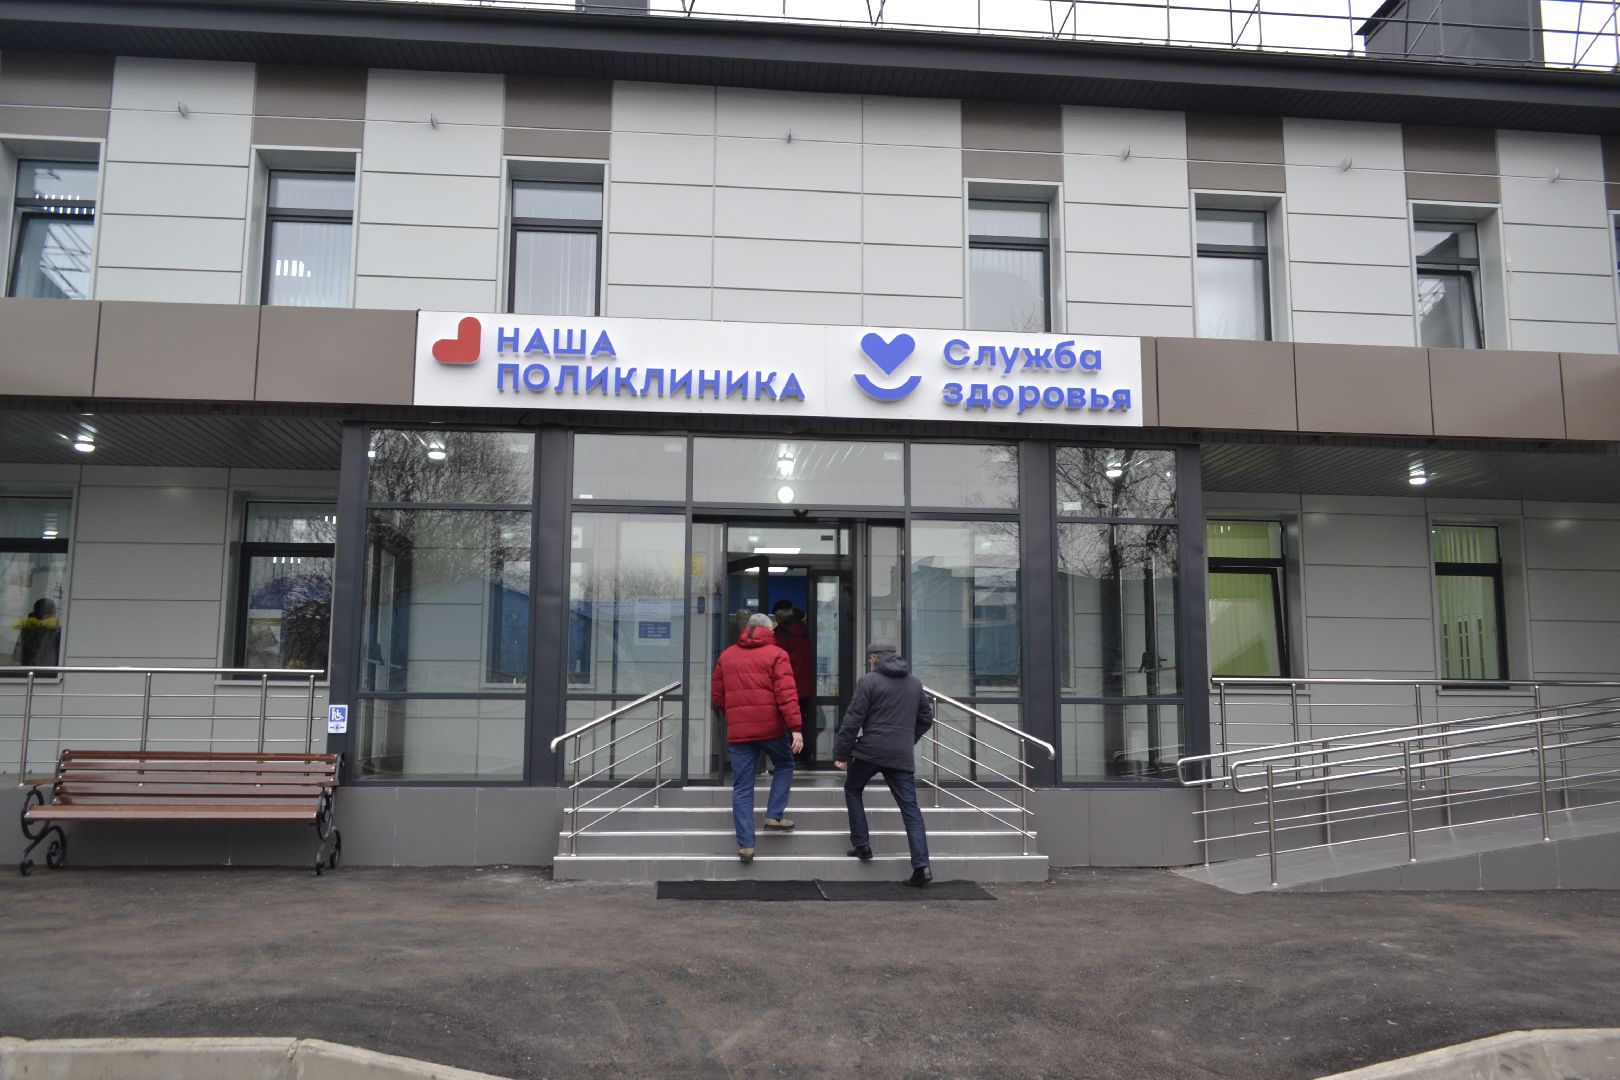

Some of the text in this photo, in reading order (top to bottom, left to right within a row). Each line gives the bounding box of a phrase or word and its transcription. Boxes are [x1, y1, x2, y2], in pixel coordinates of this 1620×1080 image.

[497, 327, 617, 357] НАША
[943, 339, 1102, 375] Служба
[497, 363, 805, 401] ПОЛИКЛИНИКА
[943, 382, 1132, 413] здоровья
